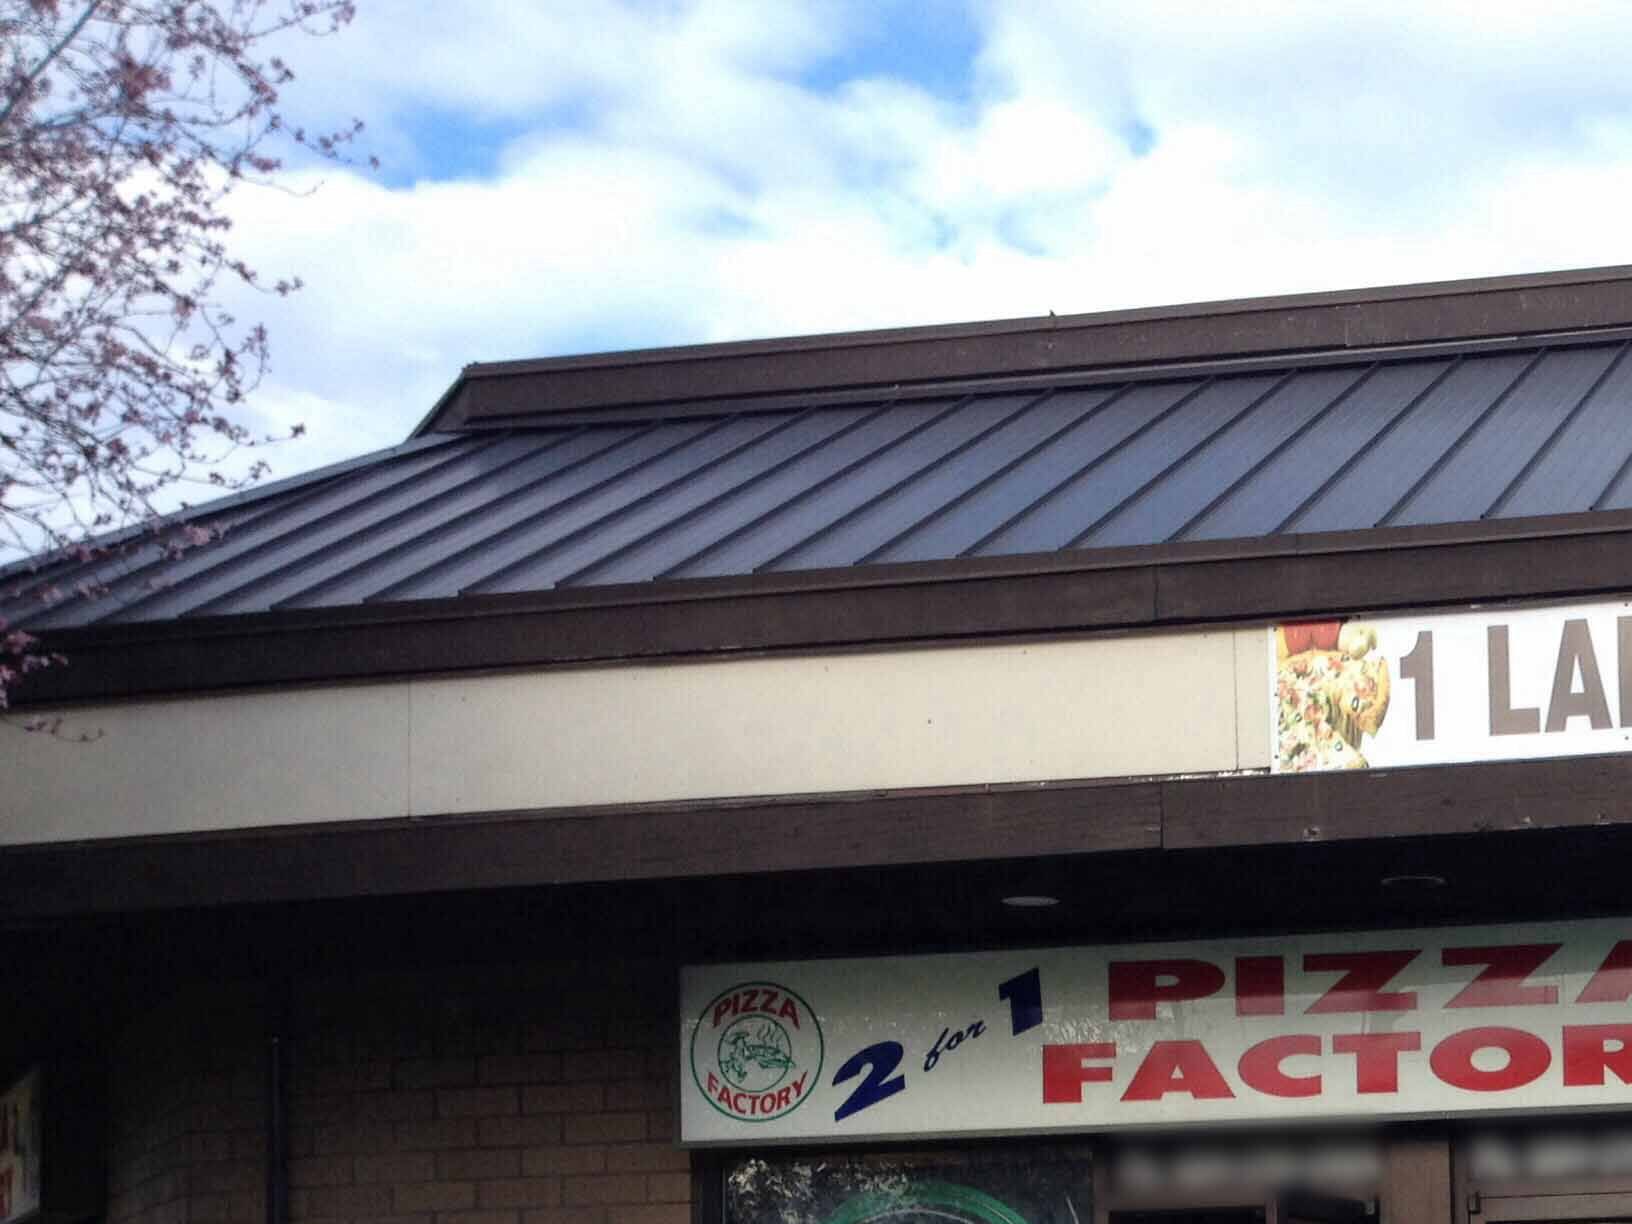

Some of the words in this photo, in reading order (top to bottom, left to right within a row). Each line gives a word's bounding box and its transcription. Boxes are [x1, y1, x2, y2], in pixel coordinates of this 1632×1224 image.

[1399, 630, 1434, 741] 1
[712, 987, 801, 1031] PIZZA
[831, 1040, 906, 1122] 2
[998, 966, 1044, 1036] 1
[705, 1068, 810, 1115] FACTORY
